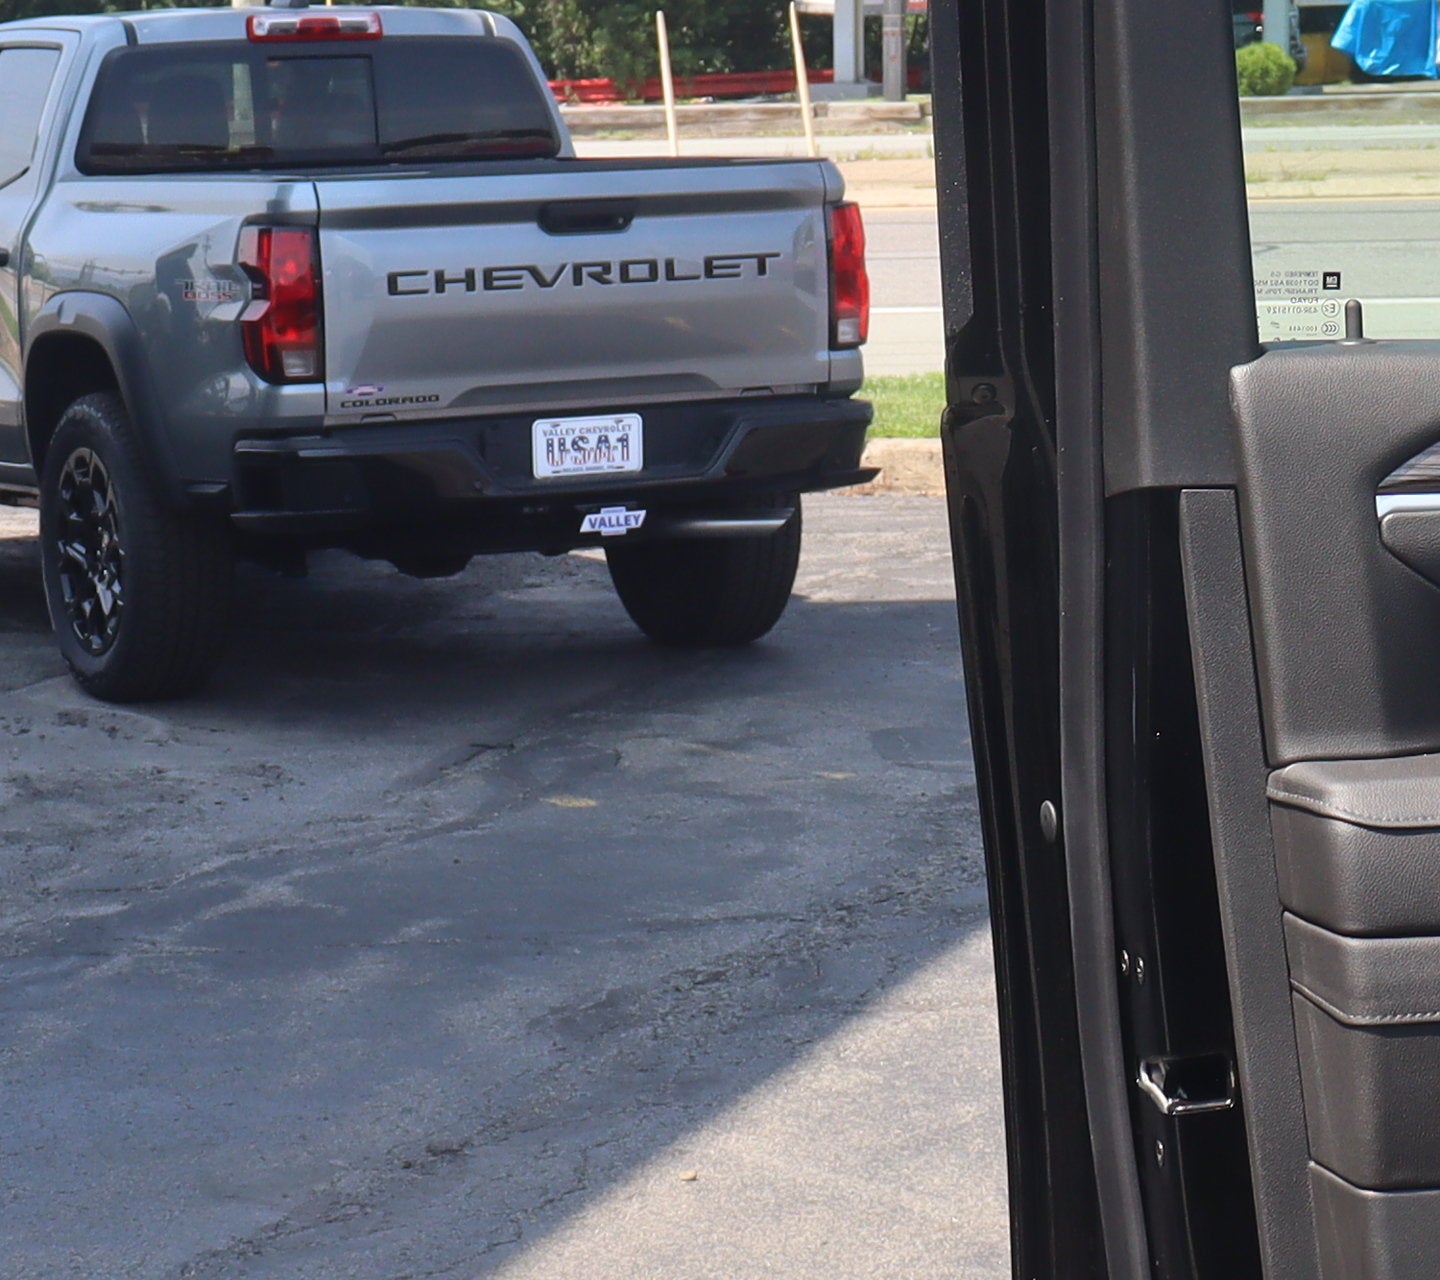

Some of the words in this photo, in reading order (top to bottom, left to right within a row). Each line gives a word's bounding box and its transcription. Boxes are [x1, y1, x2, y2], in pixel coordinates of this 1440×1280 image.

[387, 251, 781, 297] CHEVROLET
[340, 394, 440, 409] COLORADO
[542, 427, 577, 437] VALLEY
[579, 423, 632, 435] CHEVROLET
[588, 514, 642, 529] VALLEY
